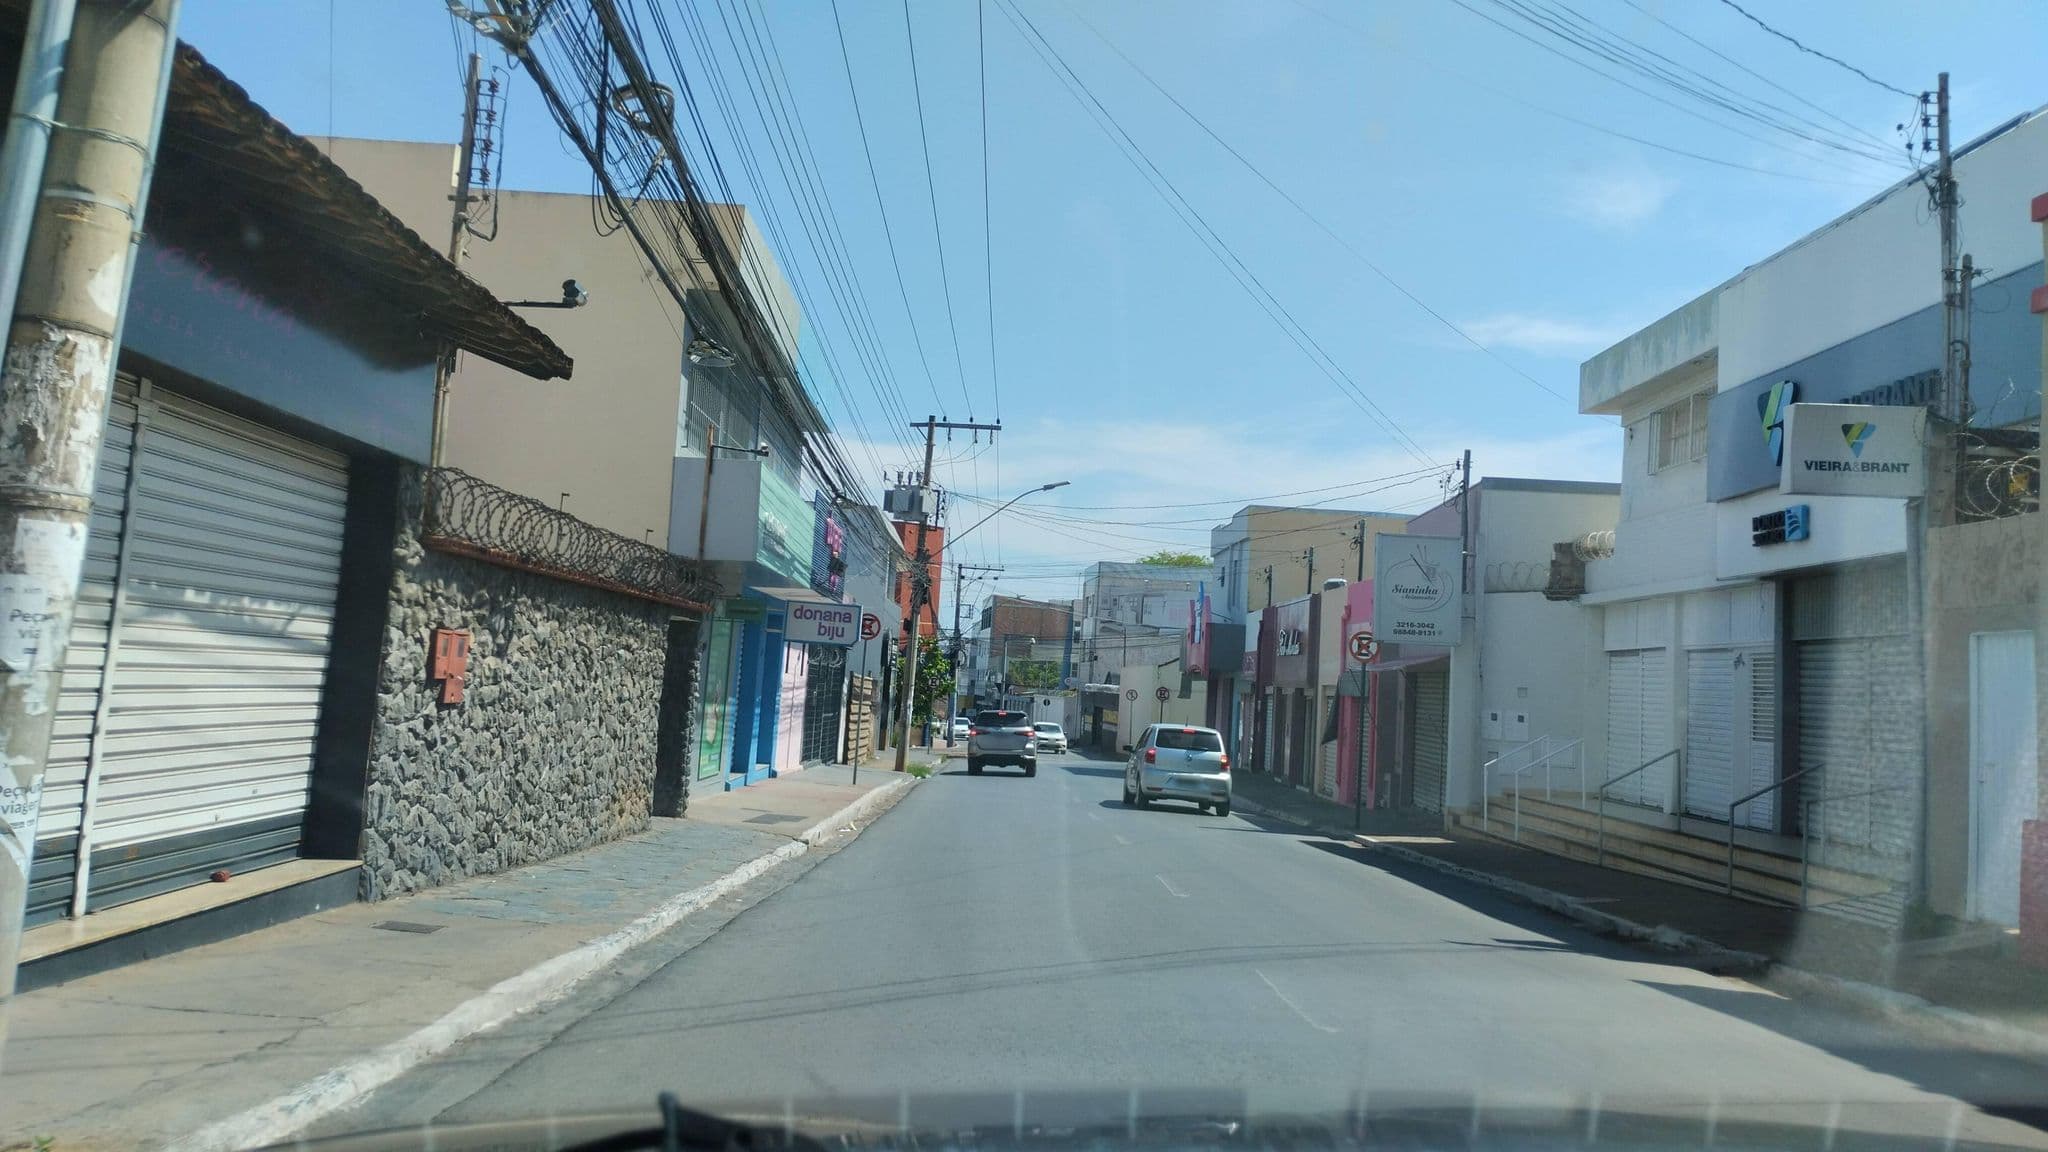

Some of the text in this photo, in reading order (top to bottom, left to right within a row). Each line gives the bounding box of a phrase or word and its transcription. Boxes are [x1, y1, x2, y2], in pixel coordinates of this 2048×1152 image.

[1804, 460, 1910, 474] VIEIRA&BRANT
[793, 605, 852, 624] donana
[817, 623, 845, 640] biju
